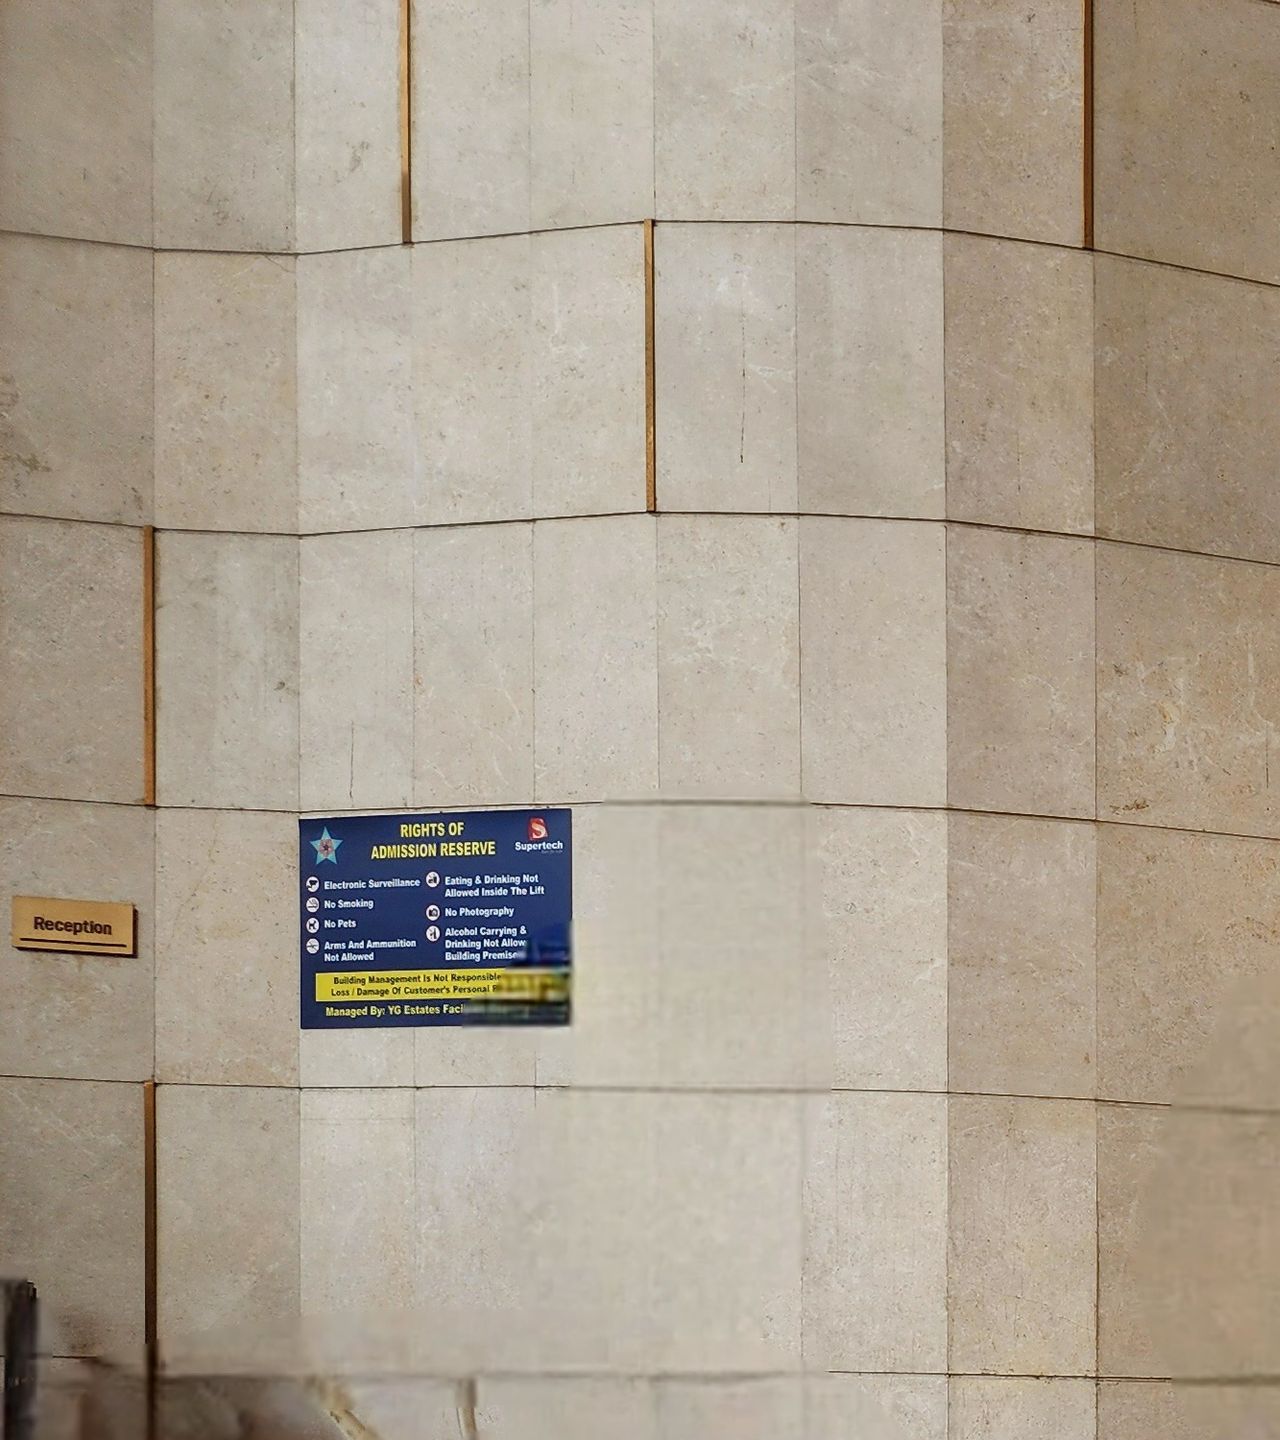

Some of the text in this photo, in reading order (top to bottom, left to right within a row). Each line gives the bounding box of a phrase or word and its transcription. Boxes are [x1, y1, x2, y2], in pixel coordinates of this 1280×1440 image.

[400, 822, 464, 838] RIGHTS OF
[371, 841, 496, 860] ADMISSION RESERVE
[515, 841, 563, 852] Supertech
[324, 878, 421, 890] Electronic Surveillance
[445, 874, 539, 887] Eating & Drinking Not
[445, 885, 545, 898] Allowed Inside The Lift
[324, 899, 374, 909] No Smoking
[445, 906, 515, 918] No Photography
[33, 916, 112, 936] Reception
[324, 919, 357, 928] No Pets
[445, 925, 527, 937] Alcohol Carrying &
[324, 938, 417, 950] Arms And Ammunition
[445, 939, 481, 950] Drinking
[483, 938, 500, 948] Not
[324, 952, 374, 962] Not Allowed
[445, 950, 526, 962] Building Premise
[333, 972, 502, 986] Building Management Is Not Responsible
[331, 988, 350, 997] Loss
[357, 987, 390, 997] Damage
[392, 986, 402, 995] Of
[404, 985, 450, 995] Customer's
[453, 984, 490, 994] Personal
[326, 1006, 368, 1018] Managed
[388, 1005, 402, 1015] YG
[404, 1004, 440, 1015] Estates
